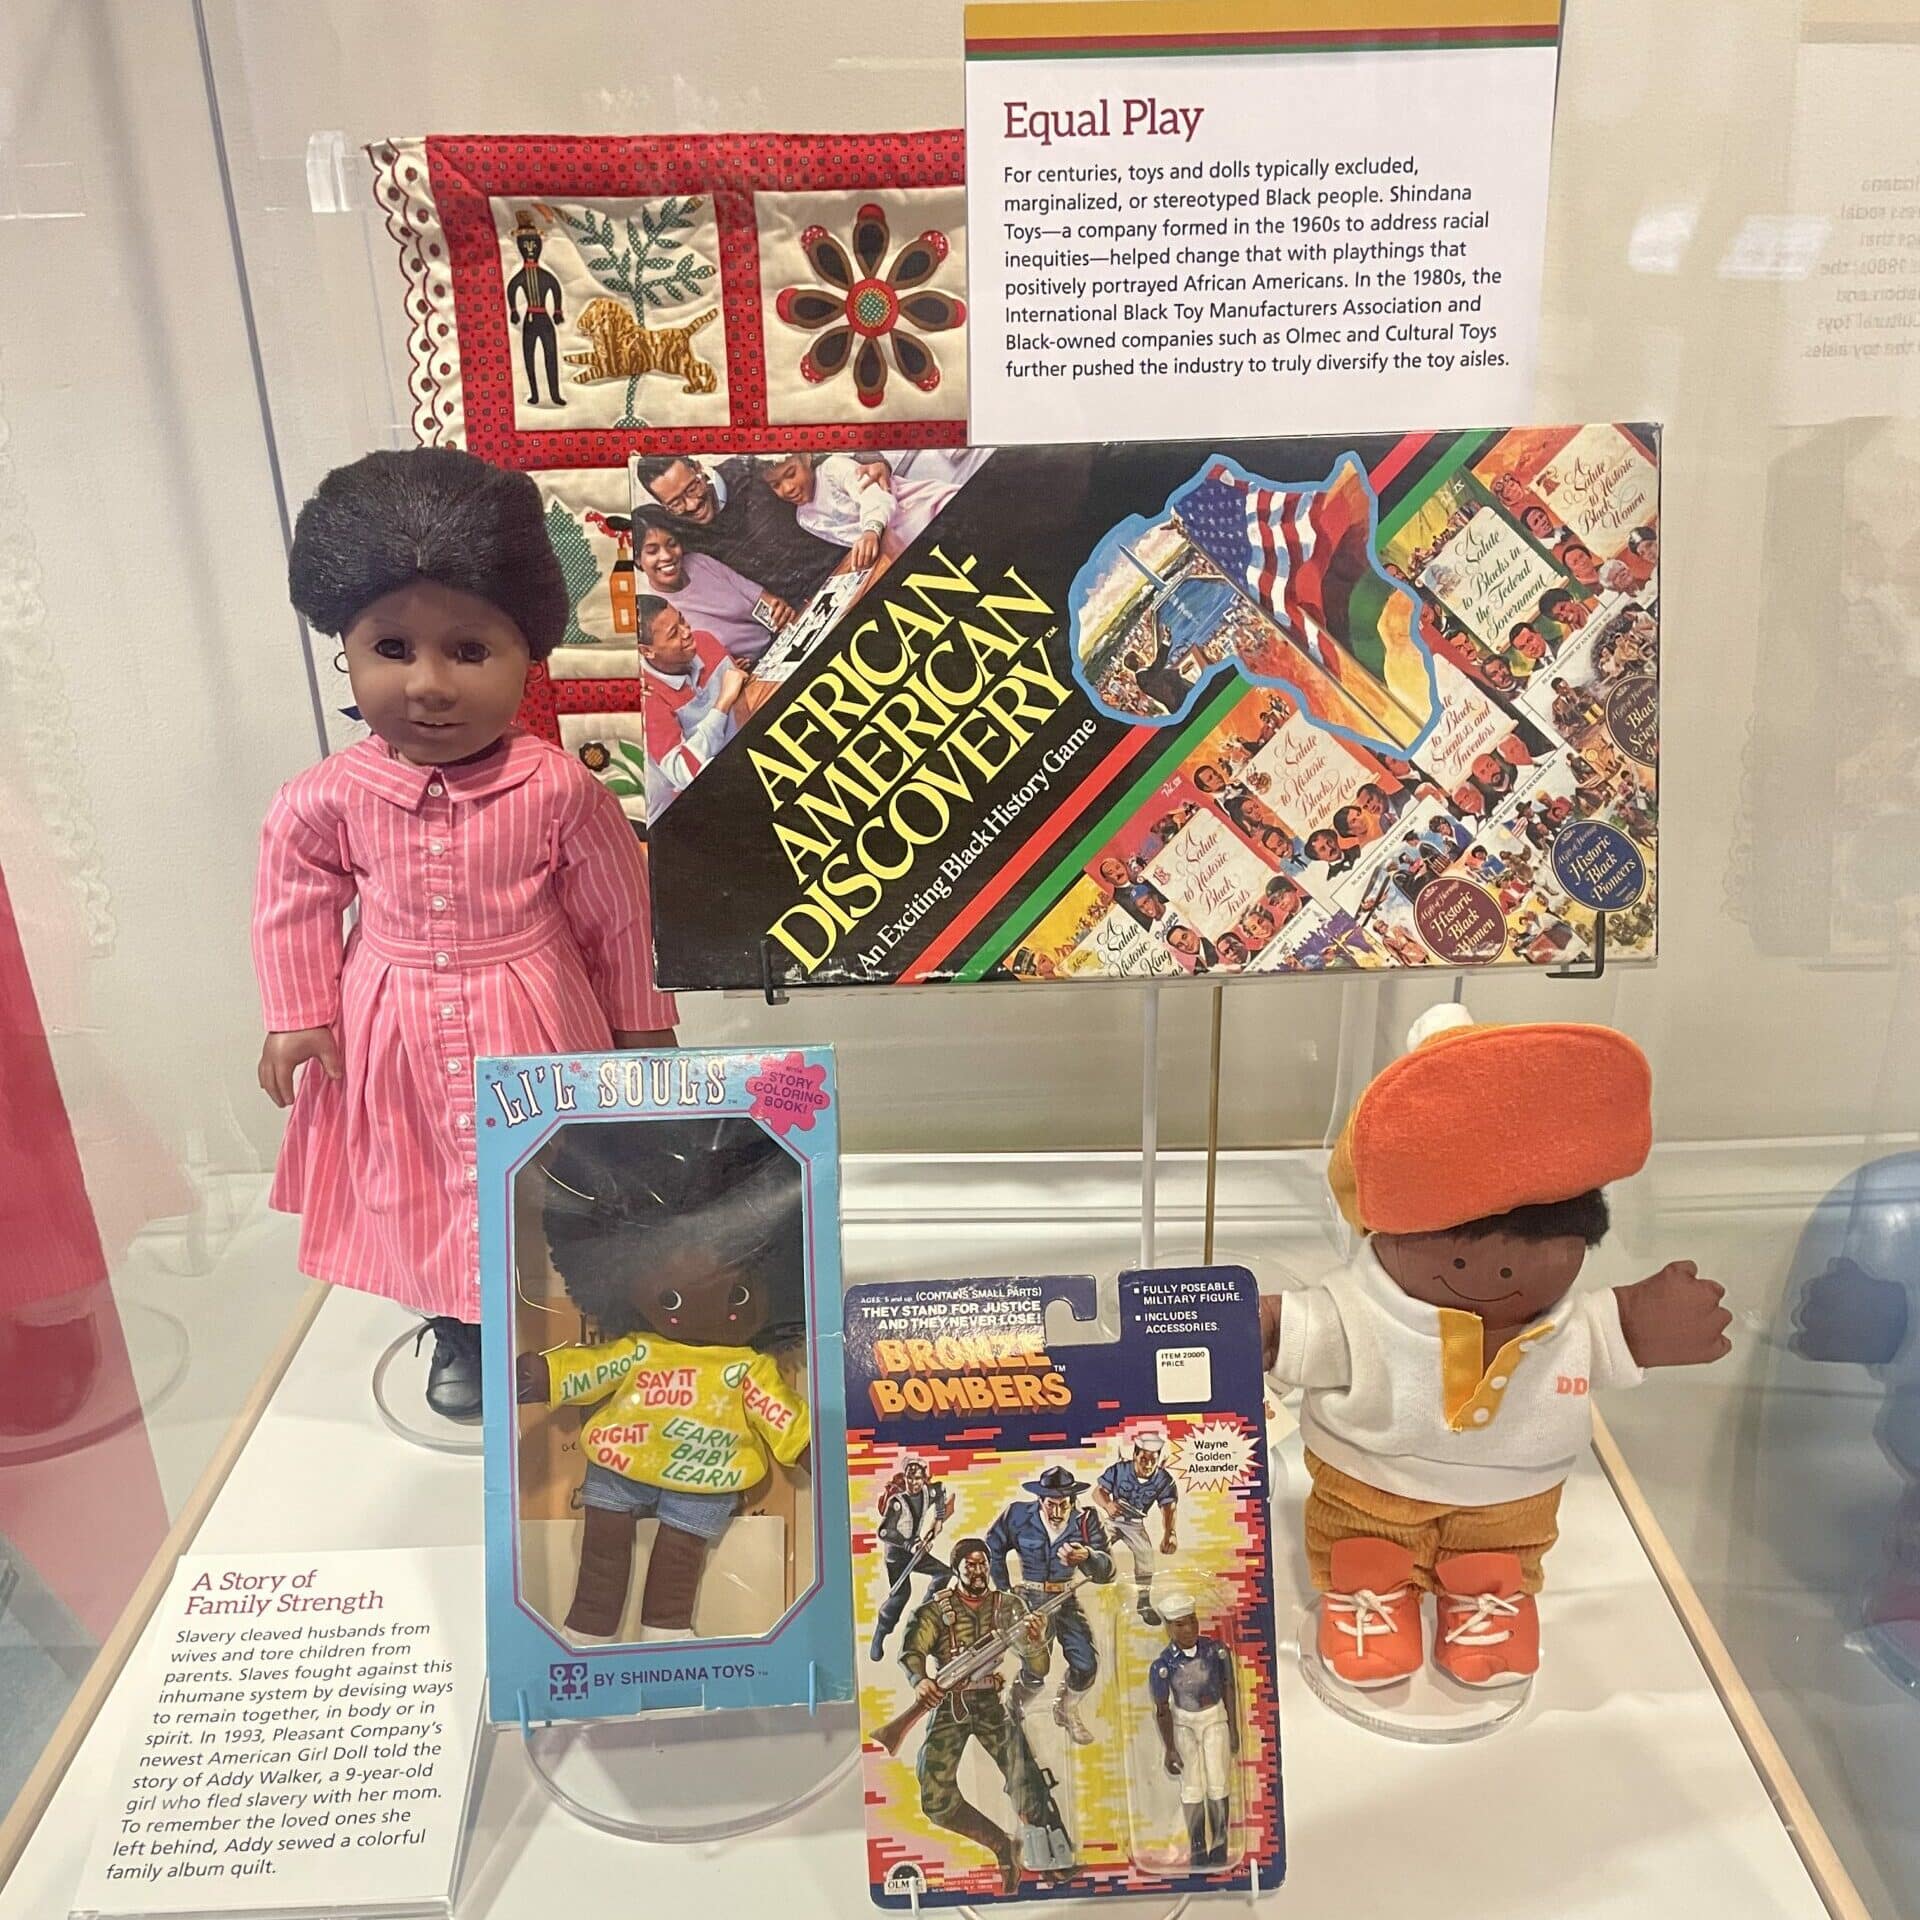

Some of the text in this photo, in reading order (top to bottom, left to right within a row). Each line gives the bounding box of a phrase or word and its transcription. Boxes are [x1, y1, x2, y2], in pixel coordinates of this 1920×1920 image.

[1003, 97, 1206, 147] Equal Play
[1004, 155, 1419, 185] For centuries, toys and dolls typically excluded,
[1005, 267, 1503, 301] positively portrayed African Americans. In the 1980s, the
[1005, 349, 1510, 381] further pushed the industry to truly diversify the toy aisles.
[1510, 545, 1520, 560] in
[746, 544, 981, 811] AFRICAN-
[771, 565, 1055, 886] AMERICAN
[1474, 701, 1490, 727] and
[767, 638, 1073, 974] DISCOVERY
[857, 715, 1098, 971] An Exciting Black History Game
[1569, 835, 1611, 885] Historic
[1585, 852, 1617, 884] Black
[1591, 859, 1636, 901] Pioneers
[1430, 891, 1473, 941] Historic
[1447, 908, 1479, 940] Black
[1452, 919, 1495, 956] Women
[491, 1056, 727, 1128] LI'L SOULS
[754, 1082, 824, 1104] COLORING
[769, 1072, 813, 1089] STORY
[764, 1096, 808, 1113] BOOK!
[916, 1289, 969, 1302] (CONTAINS
[972, 1289, 1005, 1298] SMALL
[1007, 1286, 1042, 1297] PARTS)
[1143, 1282, 1235, 1294] FULLY POSEABLE
[1144, 1292, 1243, 1305] MILITARY FIGURE.
[862, 1300, 1041, 1318] THEY STAND FOR JUSTICE
[878, 1312, 1041, 1330] AND THEY NEVER LOSE!
[1145, 1311, 1198, 1322] INCLUDES
[562, 1373, 591, 1401] I'M
[636, 1371, 674, 1389] SAY
[1556, 1376, 1589, 1396] DD
[644, 1390, 693, 1406] LOUD
[742, 1376, 792, 1430] PEACE
[870, 1373, 1071, 1419] BOMBERS
[588, 1423, 649, 1445] RIGHT
[662, 1417, 738, 1448] LEARN
[1194, 1441, 1228, 1449] Wayne
[597, 1447, 631, 1471] ON
[671, 1443, 737, 1467] BABY
[661, 1461, 742, 1487] LEARN
[1189, 1464, 1238, 1473] Alexander
[191, 1569, 319, 1594] A Story of
[184, 1590, 384, 1618] Family Strength
[176, 1622, 431, 1646] Slavery cleaved husbands from
[163, 1659, 453, 1687] parents. Slaves fought against this
[593, 1663, 755, 1687] BY SHINDANA TOYS
[112, 1828, 427, 1857] left behind, Addy sewed a colorful
[107, 1858, 277, 1883] family album quilt.
[887, 1880, 923, 1889] OLMC
